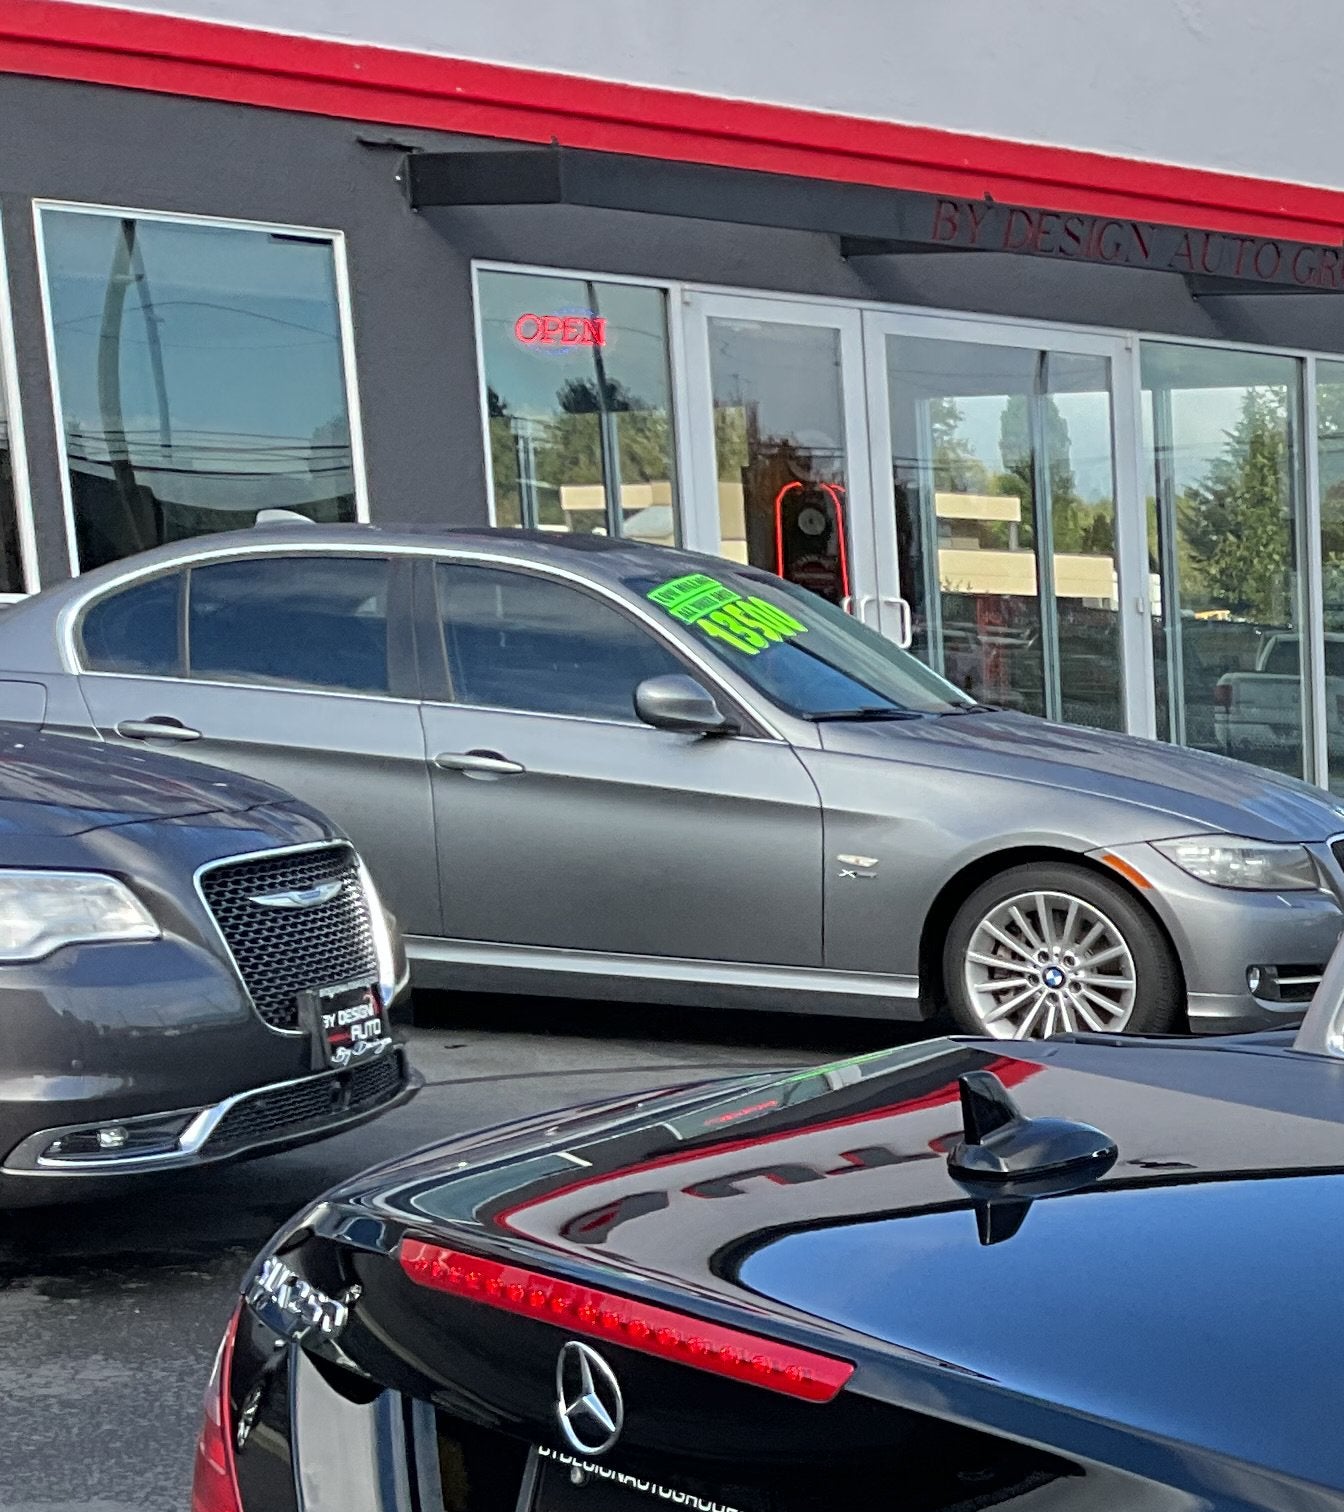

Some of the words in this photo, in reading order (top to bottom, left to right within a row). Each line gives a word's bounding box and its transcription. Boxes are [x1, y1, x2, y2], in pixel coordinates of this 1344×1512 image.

[931, 198, 994, 244] BY
[1003, 207, 1158, 261] DESIGN
[1166, 232, 1281, 280] AUTO
[515, 313, 607, 346] OPEN
[351, 1018, 382, 1042] AUTO
